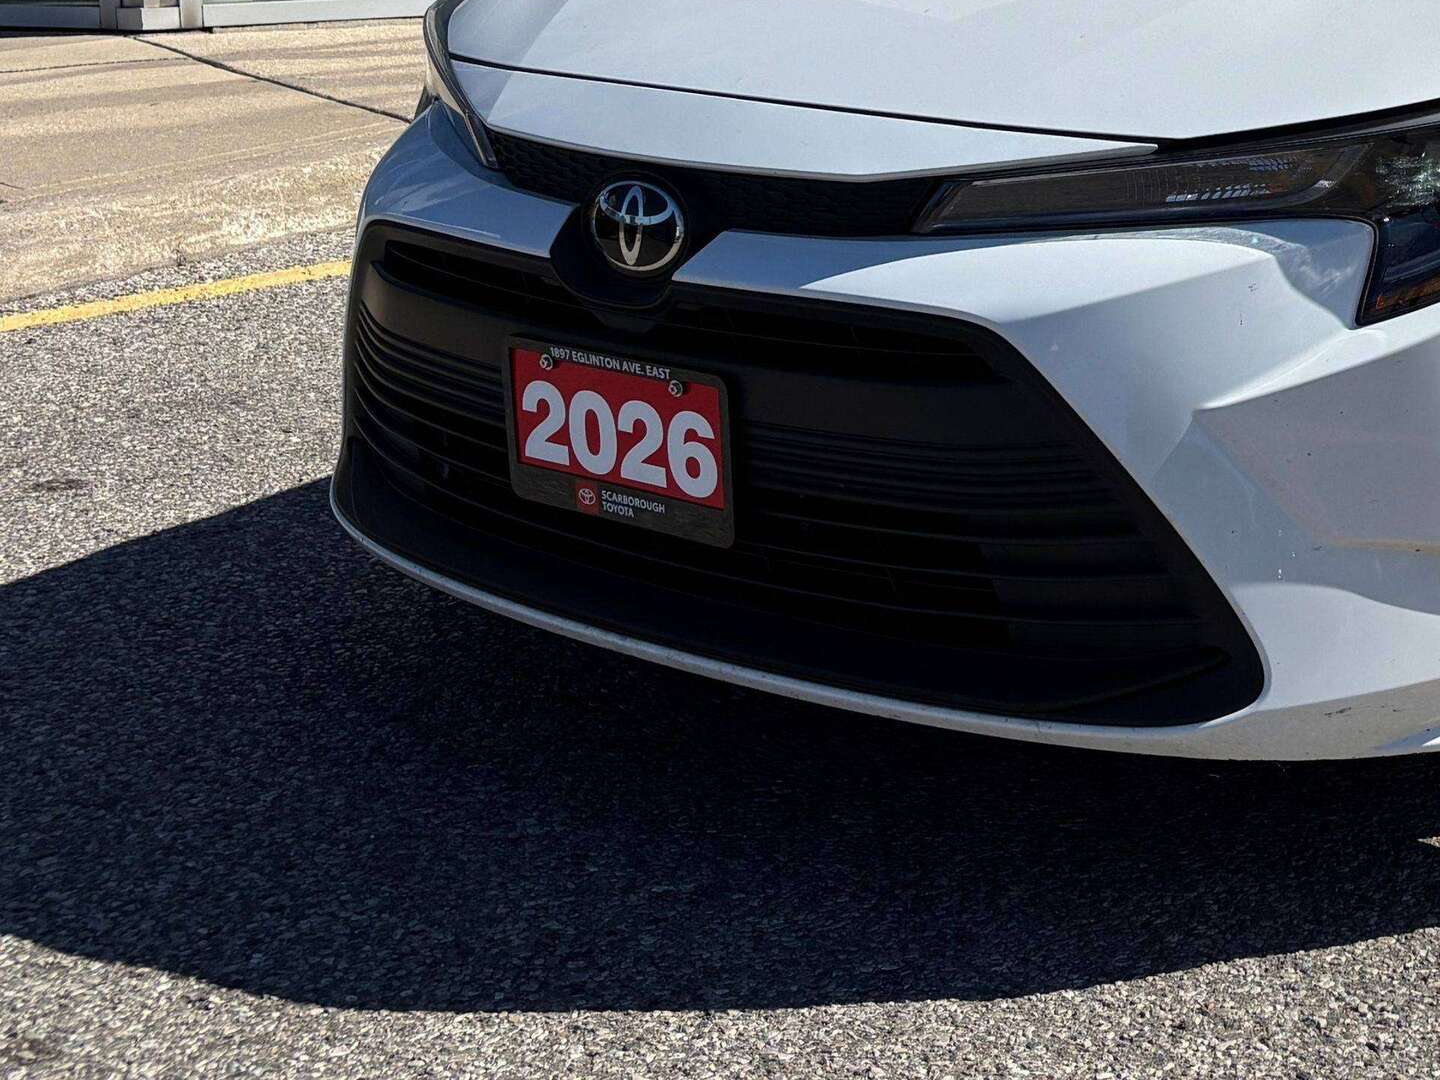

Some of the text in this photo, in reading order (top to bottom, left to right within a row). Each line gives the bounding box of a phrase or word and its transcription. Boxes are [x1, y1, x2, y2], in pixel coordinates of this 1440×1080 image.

[549, 347, 671, 380] 1897 EGLINTON AVE. EAST
[522, 380, 718, 498] 2026
[601, 490, 665, 514] SCARBOROUGH
[602, 501, 634, 518] TOYOTA
